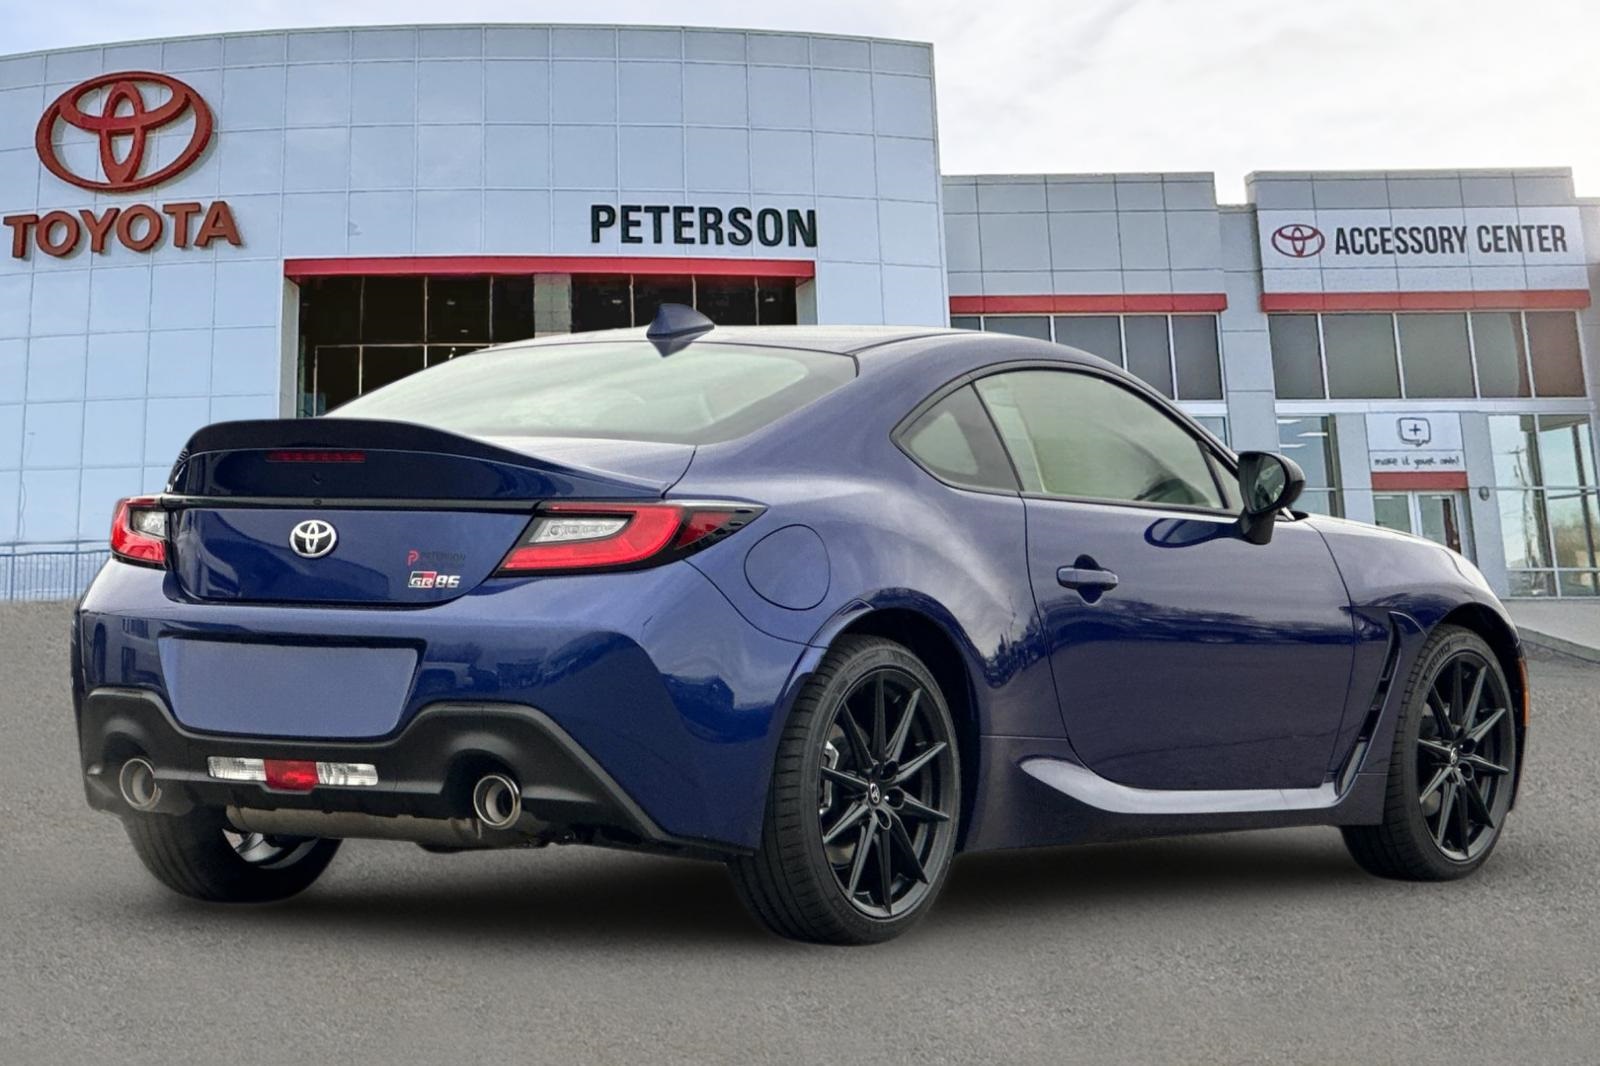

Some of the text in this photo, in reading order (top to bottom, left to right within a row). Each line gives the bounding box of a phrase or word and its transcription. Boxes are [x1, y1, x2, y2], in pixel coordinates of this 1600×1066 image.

[3, 200, 242, 259] TOYOTA
[591, 204, 818, 248] PETERSON
[1335, 224, 1568, 255] ACCESSORY CENTER
